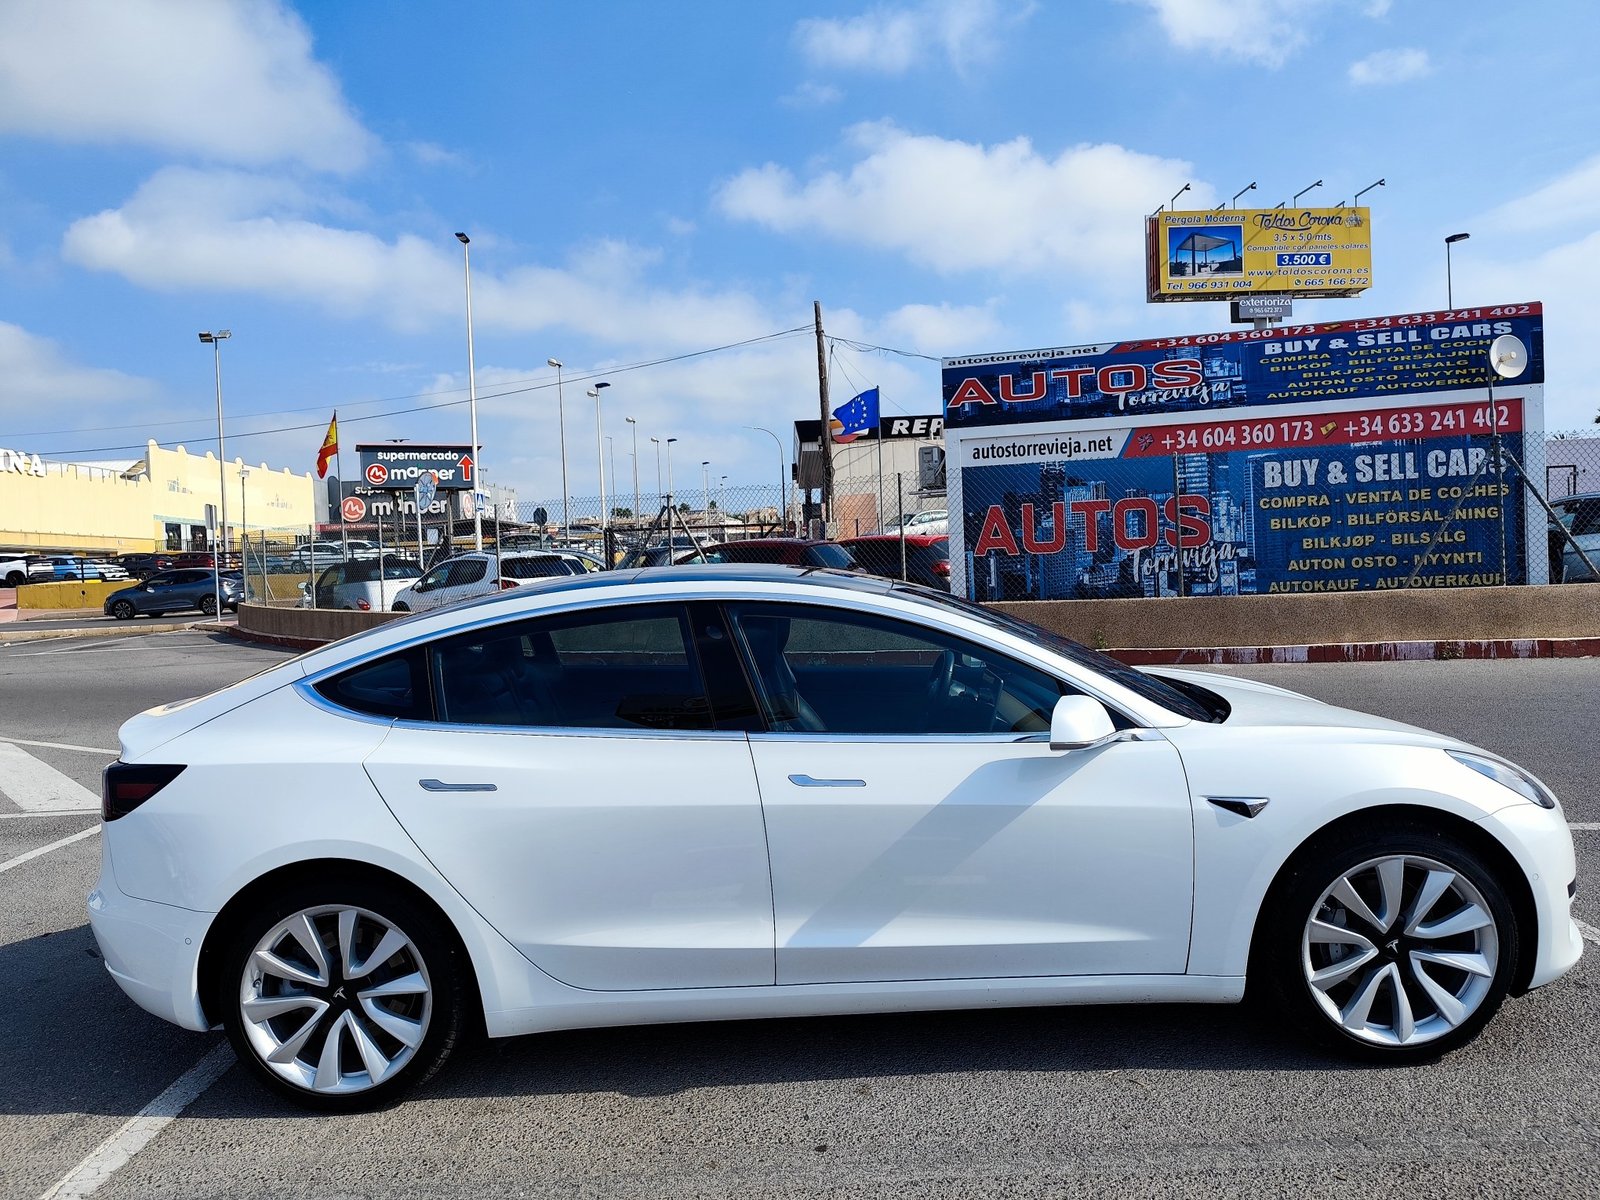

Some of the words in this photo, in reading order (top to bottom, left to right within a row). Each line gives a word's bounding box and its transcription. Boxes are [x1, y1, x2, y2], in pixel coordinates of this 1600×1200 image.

[1205, 214, 1246, 223] Moderna
[1252, 212, 1295, 231] Toldos
[1299, 211, 1344, 227] Corona
[1274, 233, 1288, 242] 3,5
[1247, 245, 1290, 253] Compatible
[1309, 244, 1338, 252] paneles
[1281, 255, 1316, 265] 3.500
[1319, 254, 1328, 264] €
[1247, 267, 1369, 277] www.toldoscorona.es
[1304, 278, 1324, 287] 665
[1328, 277, 1347, 286] 166
[1349, 277, 1369, 285] 572
[1166, 282, 1184, 290] Tel.
[1188, 281, 1208, 290] 966
[1210, 281, 1229, 289] 931
[1232, 280, 1253, 289] 004
[1239, 297, 1292, 307] exterioriza
[1348, 316, 1392, 331] +34
[1397, 313, 1437, 326] 633
[1443, 309, 1482, 322] 241
[1489, 305, 1531, 318] 402
[1151, 337, 1191, 349] +34
[1195, 333, 1232, 345] 604
[1236, 328, 1275, 341] 360
[1280, 324, 1316, 337] 173
[1264, 337, 1320, 356] BUY
[1328, 337, 1349, 351] &
[1357, 329, 1422, 348] SELL
[1430, 321, 1513, 340] CARS
[947, 345, 1099, 368] autostorrevieja.net
[1259, 351, 1331, 365] COMPRA
[1347, 345, 1404, 357] VENTA
[1411, 342, 1435, 353] DE
[1270, 360, 1332, 373] BILKÖP
[1302, 366, 1377, 379] BILKJØP
[1393, 359, 1470, 373] BILSALG
[946, 358, 1203, 409] AUTOS
[1287, 378, 1346, 389] AUTON
[1352, 373, 1399, 384] OSTO
[1415, 366, 1485, 379] MYYNTI
[1114, 382, 1230, 411] Torrevieja
[1267, 386, 1359, 399] AUTOKAUF
[1343, 416, 1384, 437] +34
[1388, 412, 1425, 434] 633
[1430, 409, 1466, 431] 241
[1472, 405, 1509, 427] 402
[1161, 429, 1198, 450] +34
[1202, 427, 1235, 447] 604
[1241, 423, 1275, 445] 360
[1280, 421, 1314, 442] 173
[377, 450, 459, 462] supermercado
[972, 436, 1113, 461] autostorrevieja.net
[1264, 458, 1320, 489] BUY
[1327, 460, 1348, 485] &
[1355, 451, 1420, 484] SELL
[1427, 446, 1508, 480] CARS
[1259, 494, 1331, 510] COMPRA
[1345, 489, 1403, 505] VENTA
[1409, 487, 1433, 501] DE
[974, 494, 1211, 558] AUTOS
[1270, 514, 1332, 530] BILKÖP
[1347, 506, 1499, 527] BILFÖRSÄLNING
[1302, 535, 1376, 550] BILKJØP
[1125, 542, 1238, 584] Torrvieja
[1288, 557, 1345, 571] AUTON
[1351, 554, 1398, 569] OSTO
[1269, 577, 1359, 593] AUTOKAUF
